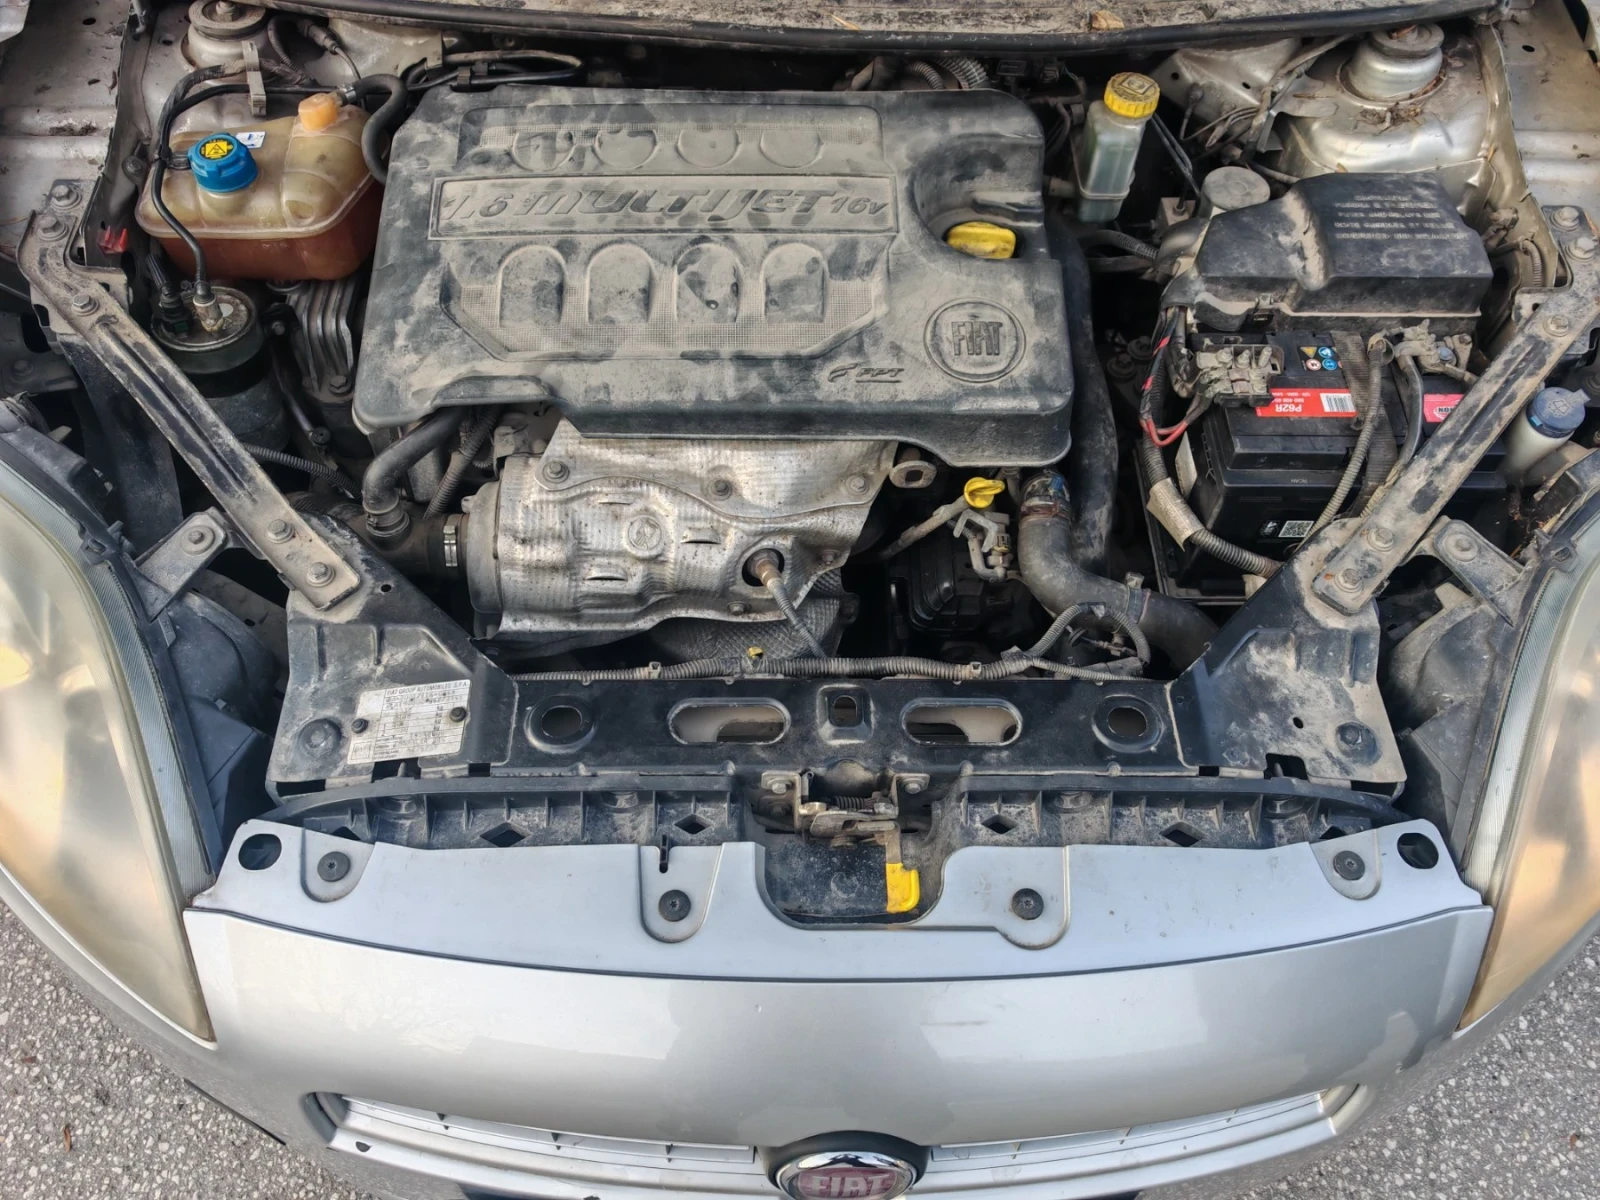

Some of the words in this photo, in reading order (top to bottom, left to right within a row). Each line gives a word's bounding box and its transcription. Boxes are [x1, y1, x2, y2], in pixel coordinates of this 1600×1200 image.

[440, 192, 514, 221] 1.6
[950, 320, 1003, 356] FIAT
[856, 367, 905, 378] FPT
[1275, 403, 1303, 413] P62R
[398, 687, 416, 695] GROUP
[416, 683, 452, 692] AUTOMOBILES
[812, 1173, 890, 1198] FIAT
